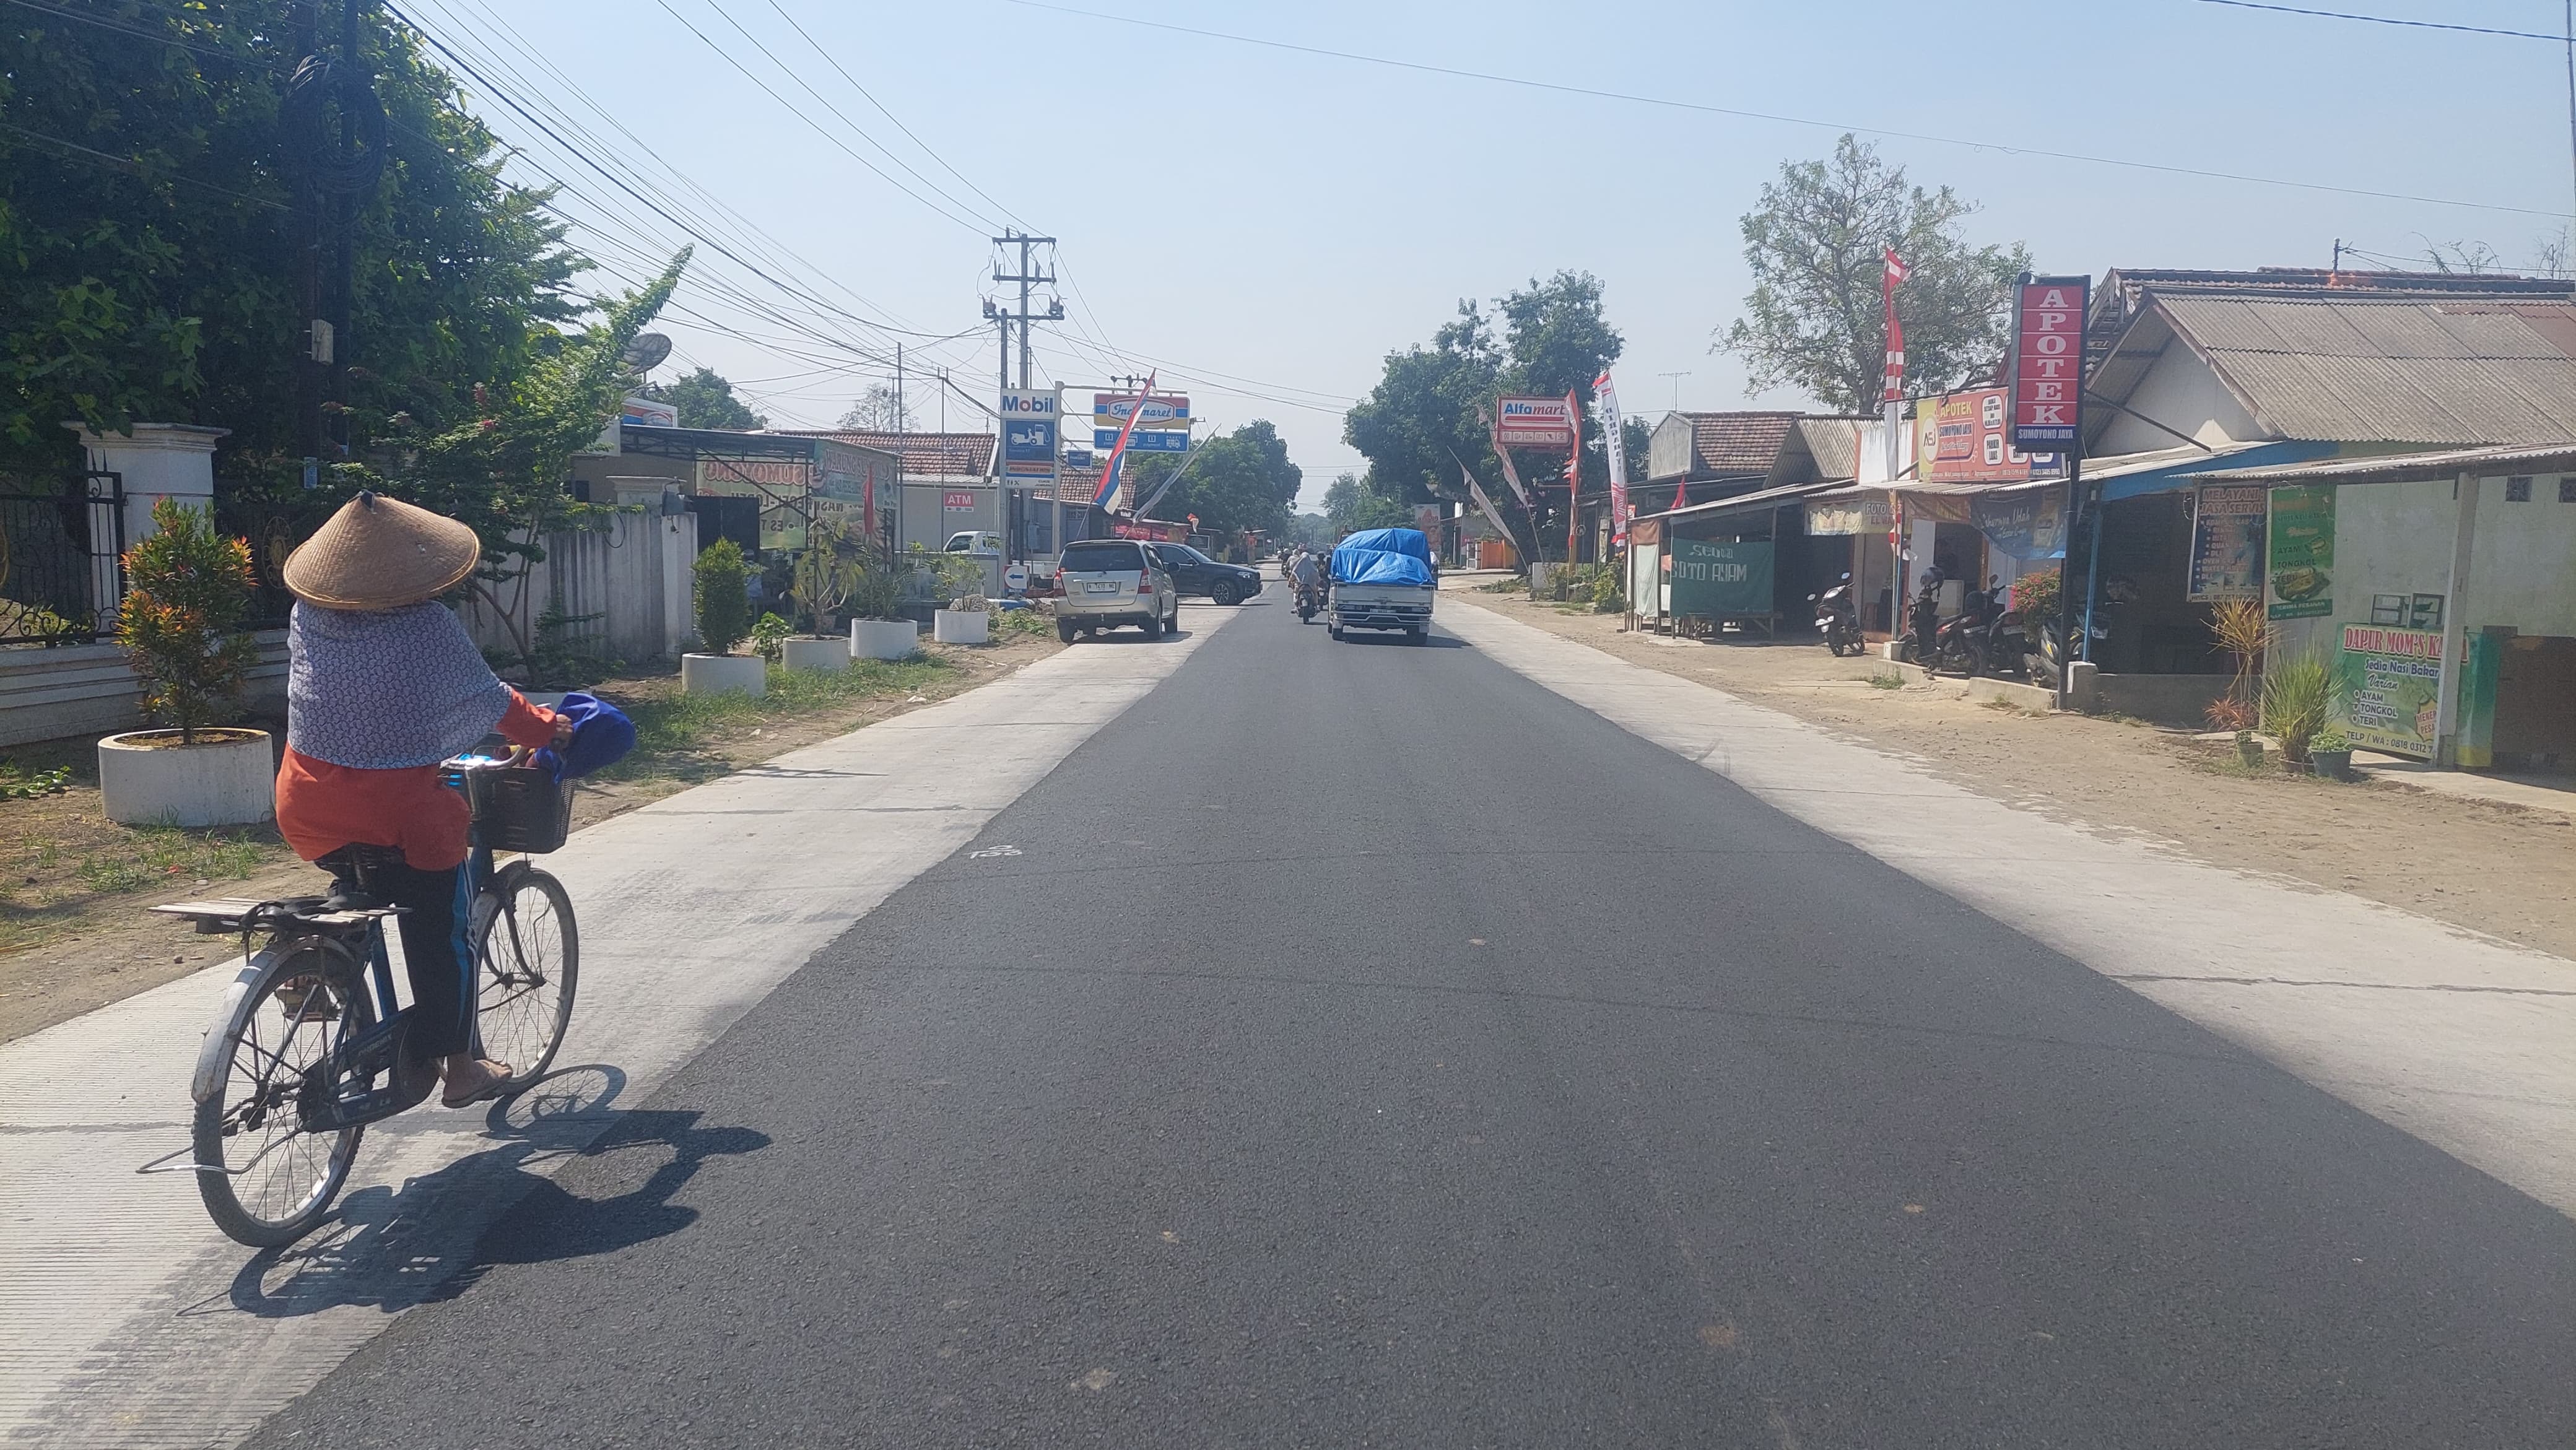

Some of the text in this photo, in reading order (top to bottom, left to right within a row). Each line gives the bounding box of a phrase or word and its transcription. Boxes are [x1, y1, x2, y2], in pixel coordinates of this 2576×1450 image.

[2032, 289, 2068, 424] APOTEK
[1002, 395, 1054, 413] Mobil
[1113, 404, 1172, 417] Inmaret
[1504, 402, 1566, 415] Alfamart
[1940, 401, 1972, 418] APOTEK
[1939, 423, 1972, 438] SUMOYONO JAYA
[2018, 428, 2073, 439] SUMOYONO JAYA
[947, 495, 972, 505] ATM
[1866, 502, 1887, 515] FOTO
[2200, 502, 2227, 516] JASA
[2228, 501, 2265, 514] SERVIS
[2278, 558, 2317, 568] TONGKOL
[1671, 560, 1747, 582] SOTO AYAM
[2344, 627, 2383, 652] DAPUR
[2385, 631, 2426, 656] MOM'S
[2365, 658, 2439, 677] Sedia Nasi Bakar
[2367, 674, 2398, 690] Varian
[2361, 693, 2383, 701] AYAM
[2360, 703, 2397, 717] TONGKOL
[2359, 716, 2377, 726] TERI
[2346, 731, 2364, 740] TELP
[2372, 735, 2385, 744] WA
